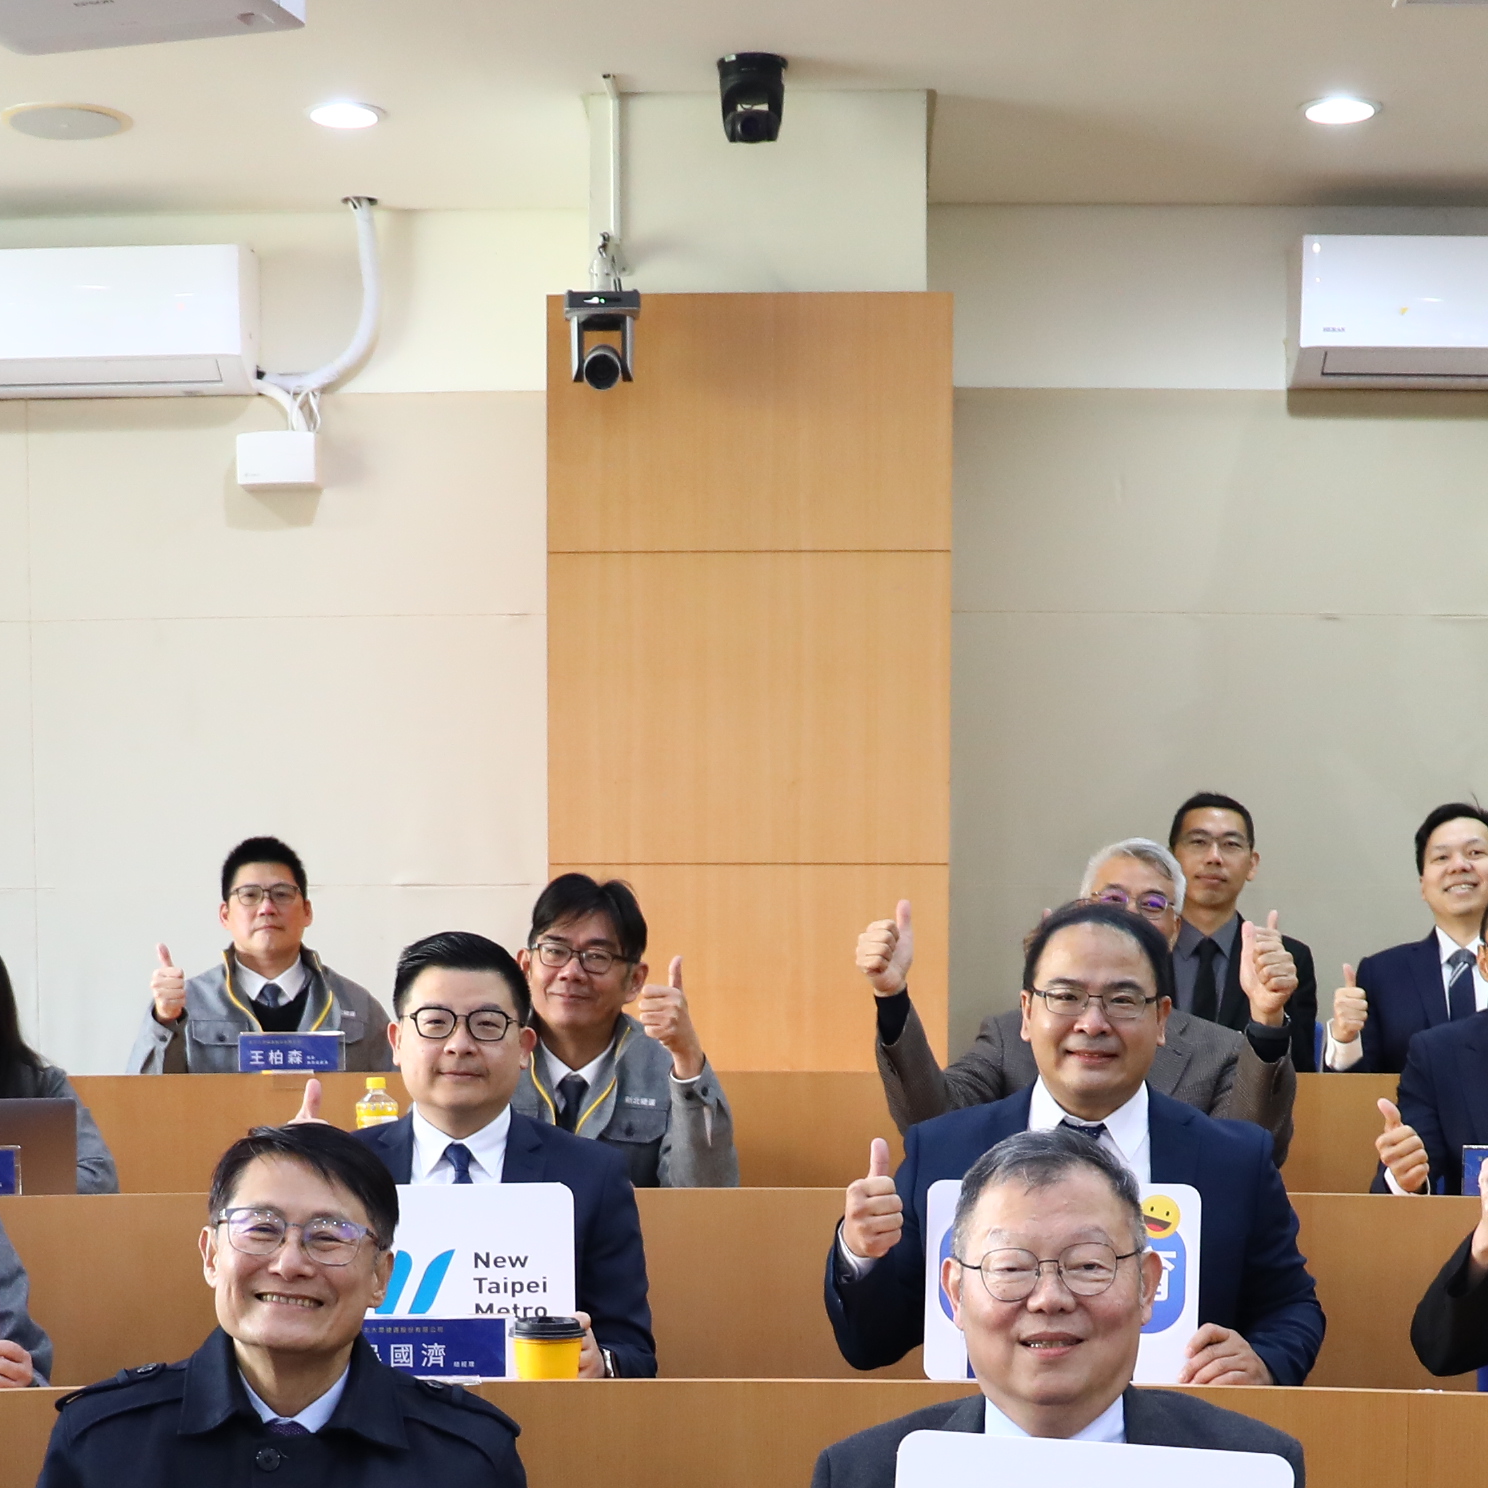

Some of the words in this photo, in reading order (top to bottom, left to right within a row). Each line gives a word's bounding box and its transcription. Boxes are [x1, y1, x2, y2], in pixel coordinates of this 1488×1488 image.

[249, 1049, 303, 1065] 王柏森
[474, 1252, 529, 1269] New
[473, 1277, 548, 1298] Taipei
[474, 1302, 548, 1319] Metro
